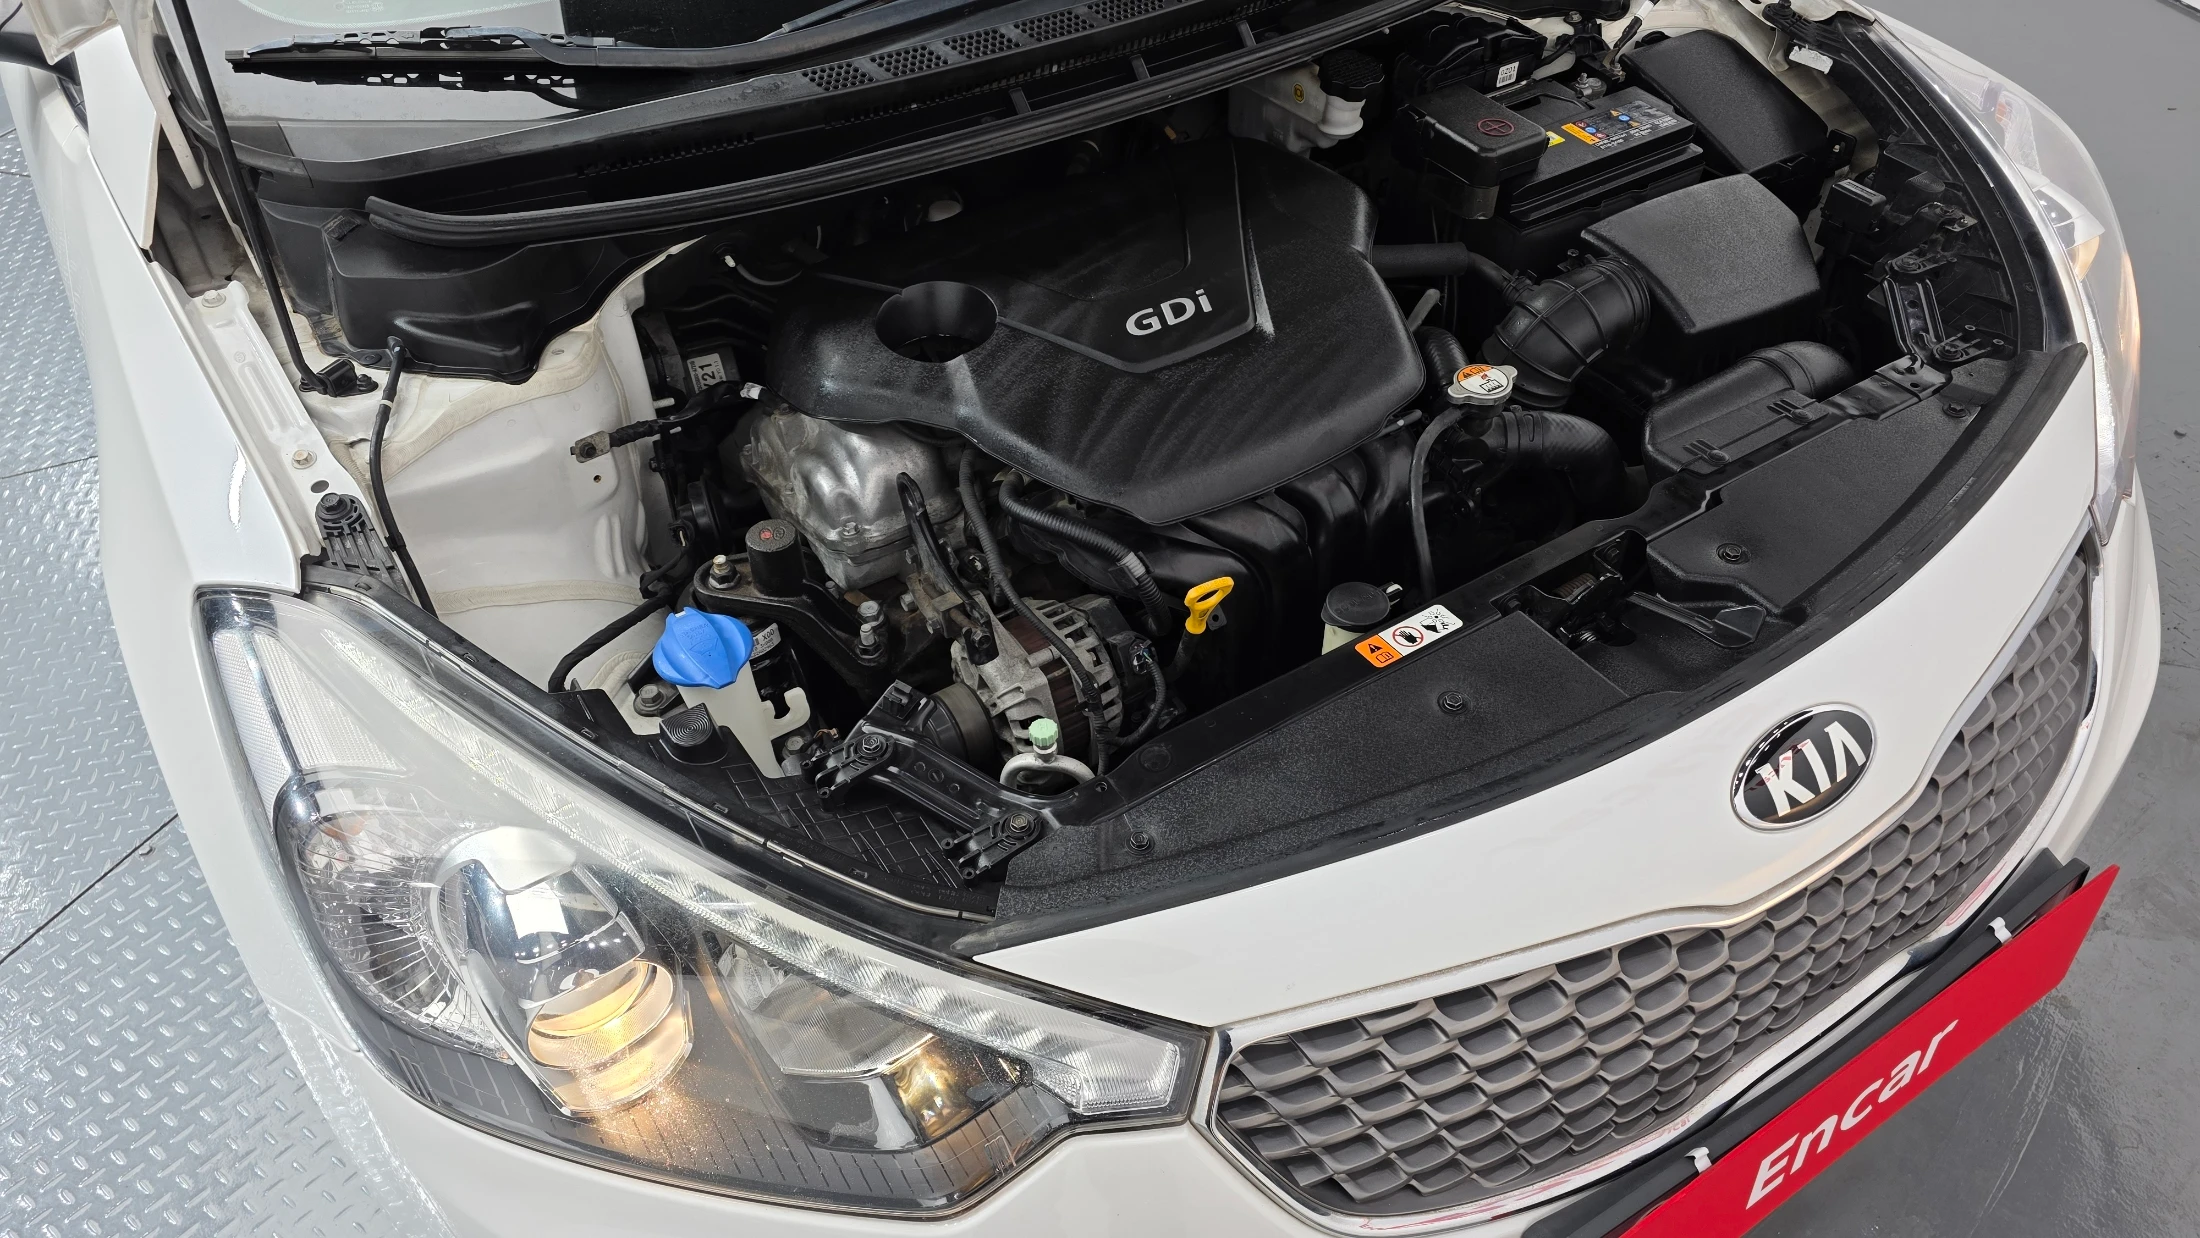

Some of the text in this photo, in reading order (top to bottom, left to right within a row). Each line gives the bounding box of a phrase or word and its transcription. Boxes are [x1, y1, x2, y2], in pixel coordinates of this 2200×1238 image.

[1125, 288, 1213, 337] GDi
[1755, 721, 1867, 818] KIA
[1745, 1019, 1959, 1210] Encar
